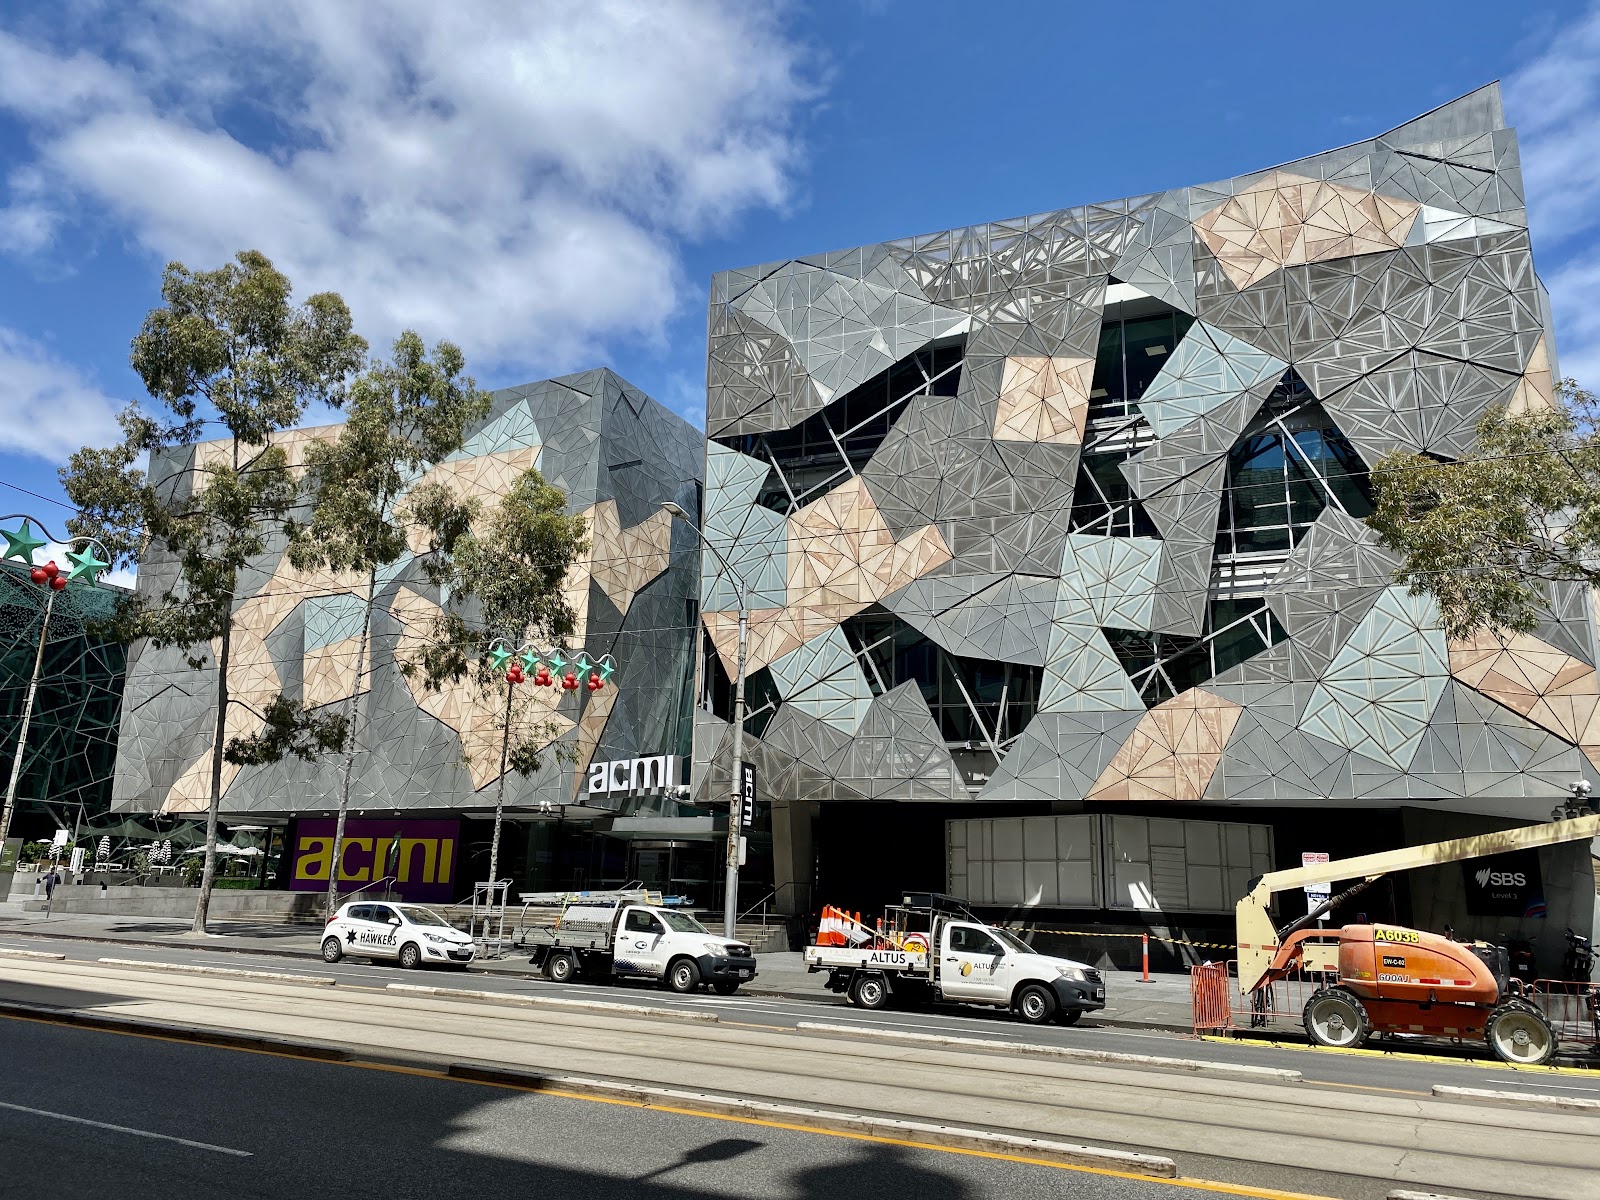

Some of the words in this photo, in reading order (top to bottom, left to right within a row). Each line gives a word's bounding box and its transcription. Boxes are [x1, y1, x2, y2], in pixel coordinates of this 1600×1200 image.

[588, 755, 674, 793] acmi
[743, 767, 754, 827] acmi
[295, 837, 454, 883] acmi
[1490, 872, 1526, 886] SBS
[360, 932, 397, 946] HAWKERS
[1375, 929, 1419, 943] A6038
[870, 952, 906, 964] ALTUS
[973, 962, 995, 970] ALTUS
[1378, 973, 1410, 983] 600AJ
